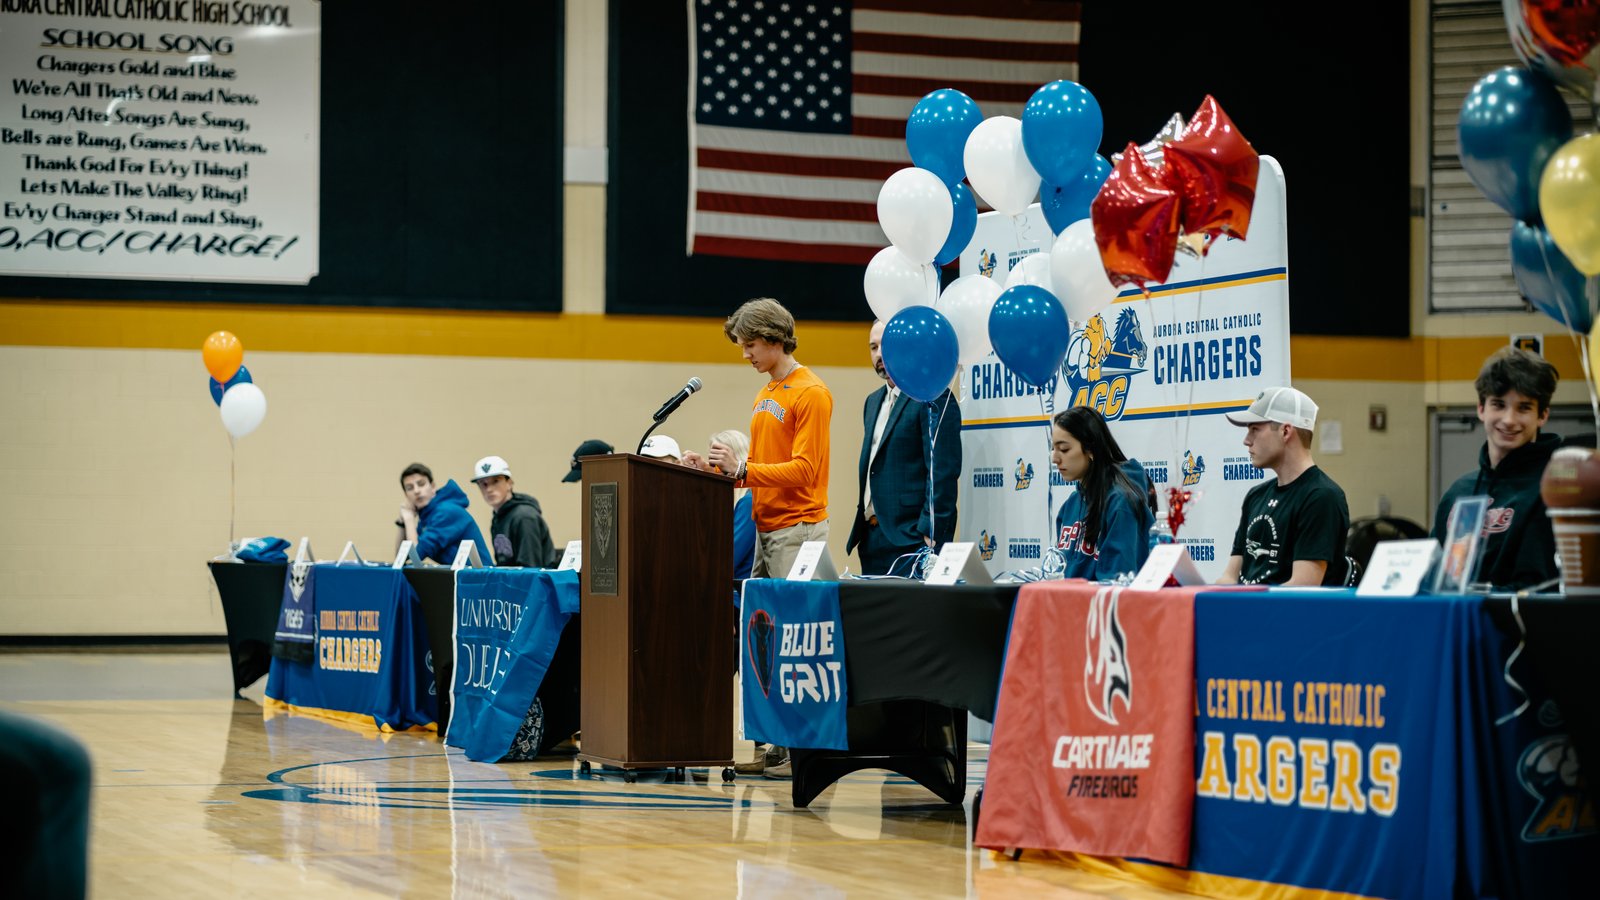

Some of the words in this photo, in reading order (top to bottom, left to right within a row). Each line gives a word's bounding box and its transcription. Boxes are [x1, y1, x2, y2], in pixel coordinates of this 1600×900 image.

[45, 0, 111, 17] CENTRAL
[115, 0, 189, 22] CATHOLIC
[193, 1, 228, 24] HIGH
[231, 0, 293, 27] SCHOOL
[40, 28, 153, 52] SCHOOL
[155, 33, 235, 55] SONG
[37, 55, 116, 76] Chargers
[119, 58, 160, 75] Gold
[163, 61, 194, 78] and
[199, 62, 237, 79] Blue
[13, 79, 62, 96] We're
[64, 81, 91, 98] All
[96, 82, 144, 100] That's
[148, 85, 177, 101] Old
[182, 87, 213, 103] and
[22, 104, 63, 123] Long
[66, 106, 109, 122] After
[115, 107, 166, 128] Songs
[168, 110, 197, 127] Are
[201, 111, 250, 132] Sung,
[1, 128, 41, 144] Bells
[46, 134, 73, 146] are
[77, 130, 127, 152] Rung,
[130, 132, 187, 149] Games
[190, 136, 220, 152] Are
[224, 137, 267, 154] Won.
[22, 154, 77, 171] Thank
[80, 155, 115, 172] God
[119, 157, 145, 173] For
[150, 158, 190, 180] Ev'ry
[192, 160, 249, 181] Thing!
[21, 178, 57, 194] Lets
[61, 179, 109, 196] Make
[111, 180, 144, 197] The
[147, 181, 198, 203] Valley
[201, 183, 249, 205] Ring!
[4, 202, 48, 224] Ev'ry
[52, 203, 121, 226] Charger
[124, 206, 177, 223] Stand
[181, 208, 215, 224] and
[218, 209, 263, 230] Sing,
[125, 231, 299, 260] CHARGE!
[1153, 323, 1182, 338] AURORA
[1185, 318, 1219, 335] CENTRAL
[1223, 313, 1262, 330] CATHOLIC
[1154, 334, 1262, 385] CHARGERS
[973, 473, 1004, 488] CHARGERS
[1009, 544, 1041, 559] CHARGERS
[779, 621, 835, 657] BLUE
[319, 636, 382, 674] CHARGERS
[779, 661, 842, 704] GRIT
[1207, 678, 1286, 723] CENTRAL
[1293, 681, 1386, 728] CATHOLIC
[1196, 731, 1401, 818] ARGERS
